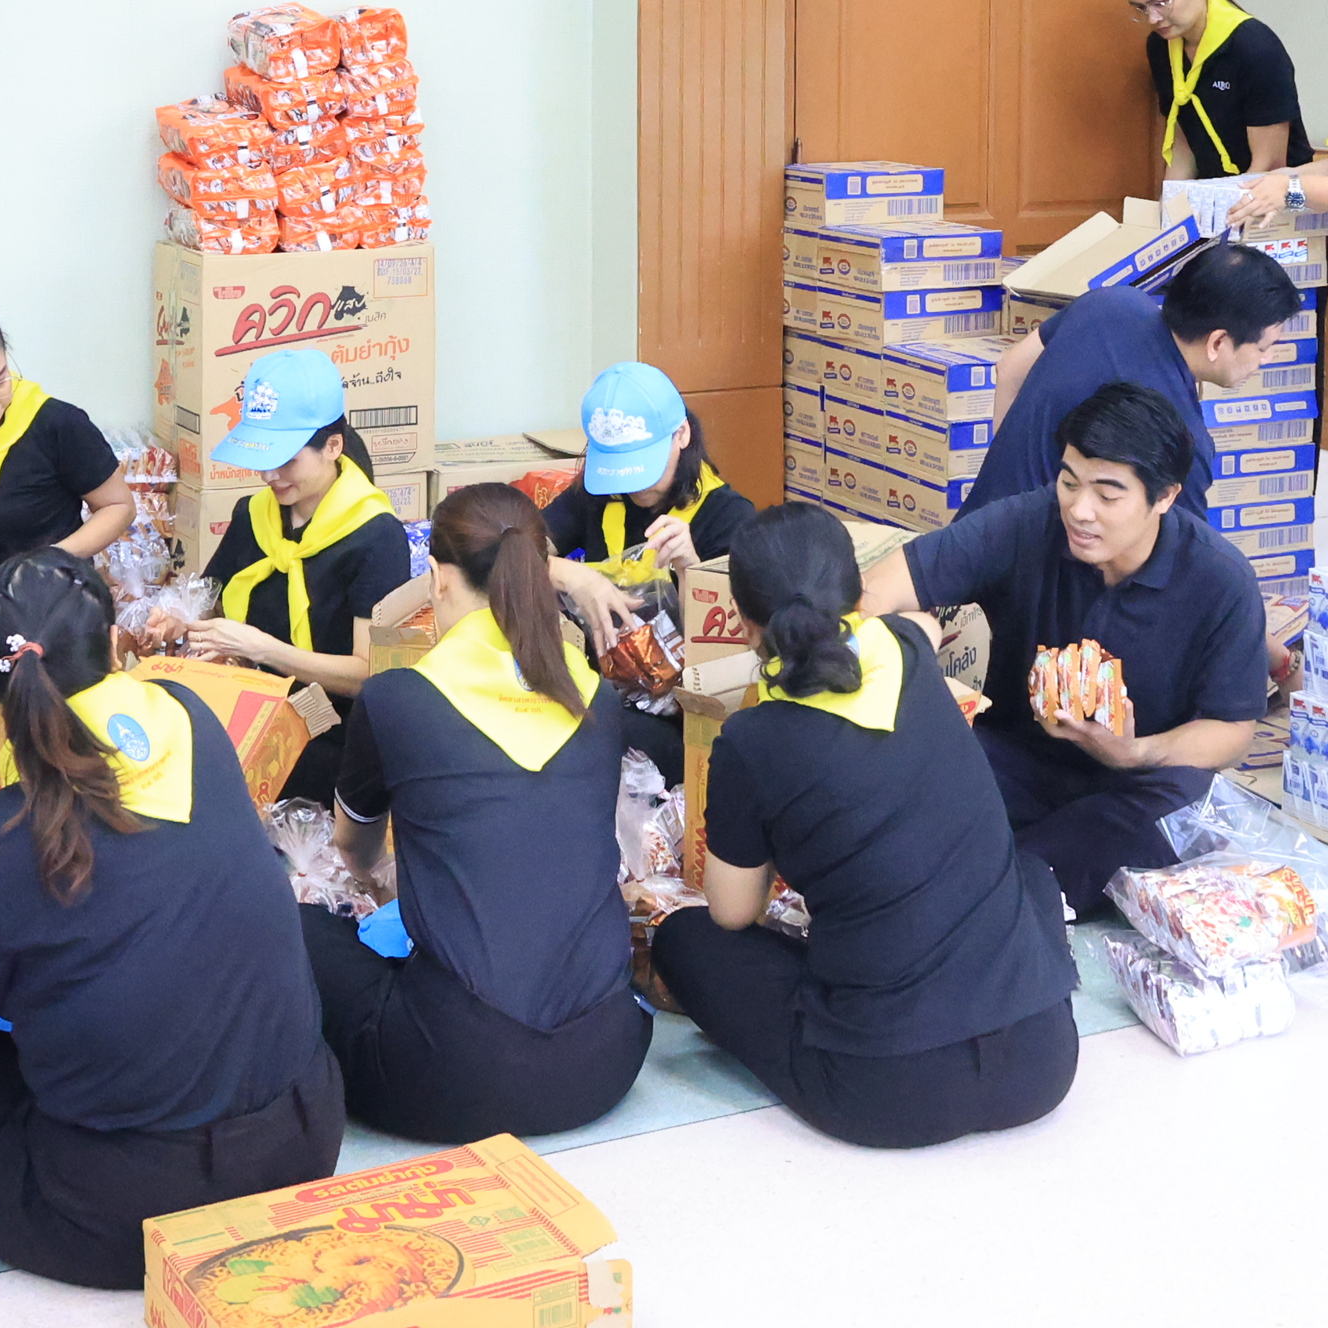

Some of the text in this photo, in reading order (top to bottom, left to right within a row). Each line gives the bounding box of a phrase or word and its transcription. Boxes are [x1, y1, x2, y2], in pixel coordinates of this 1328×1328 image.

[232, 285, 333, 345] ควิก
[331, 335, 411, 365] ต้มยำกุ้ง
[312, 1162, 438, 1199] รสต้มยำกุ้ง
[336, 1181, 477, 1234] มาม่า
